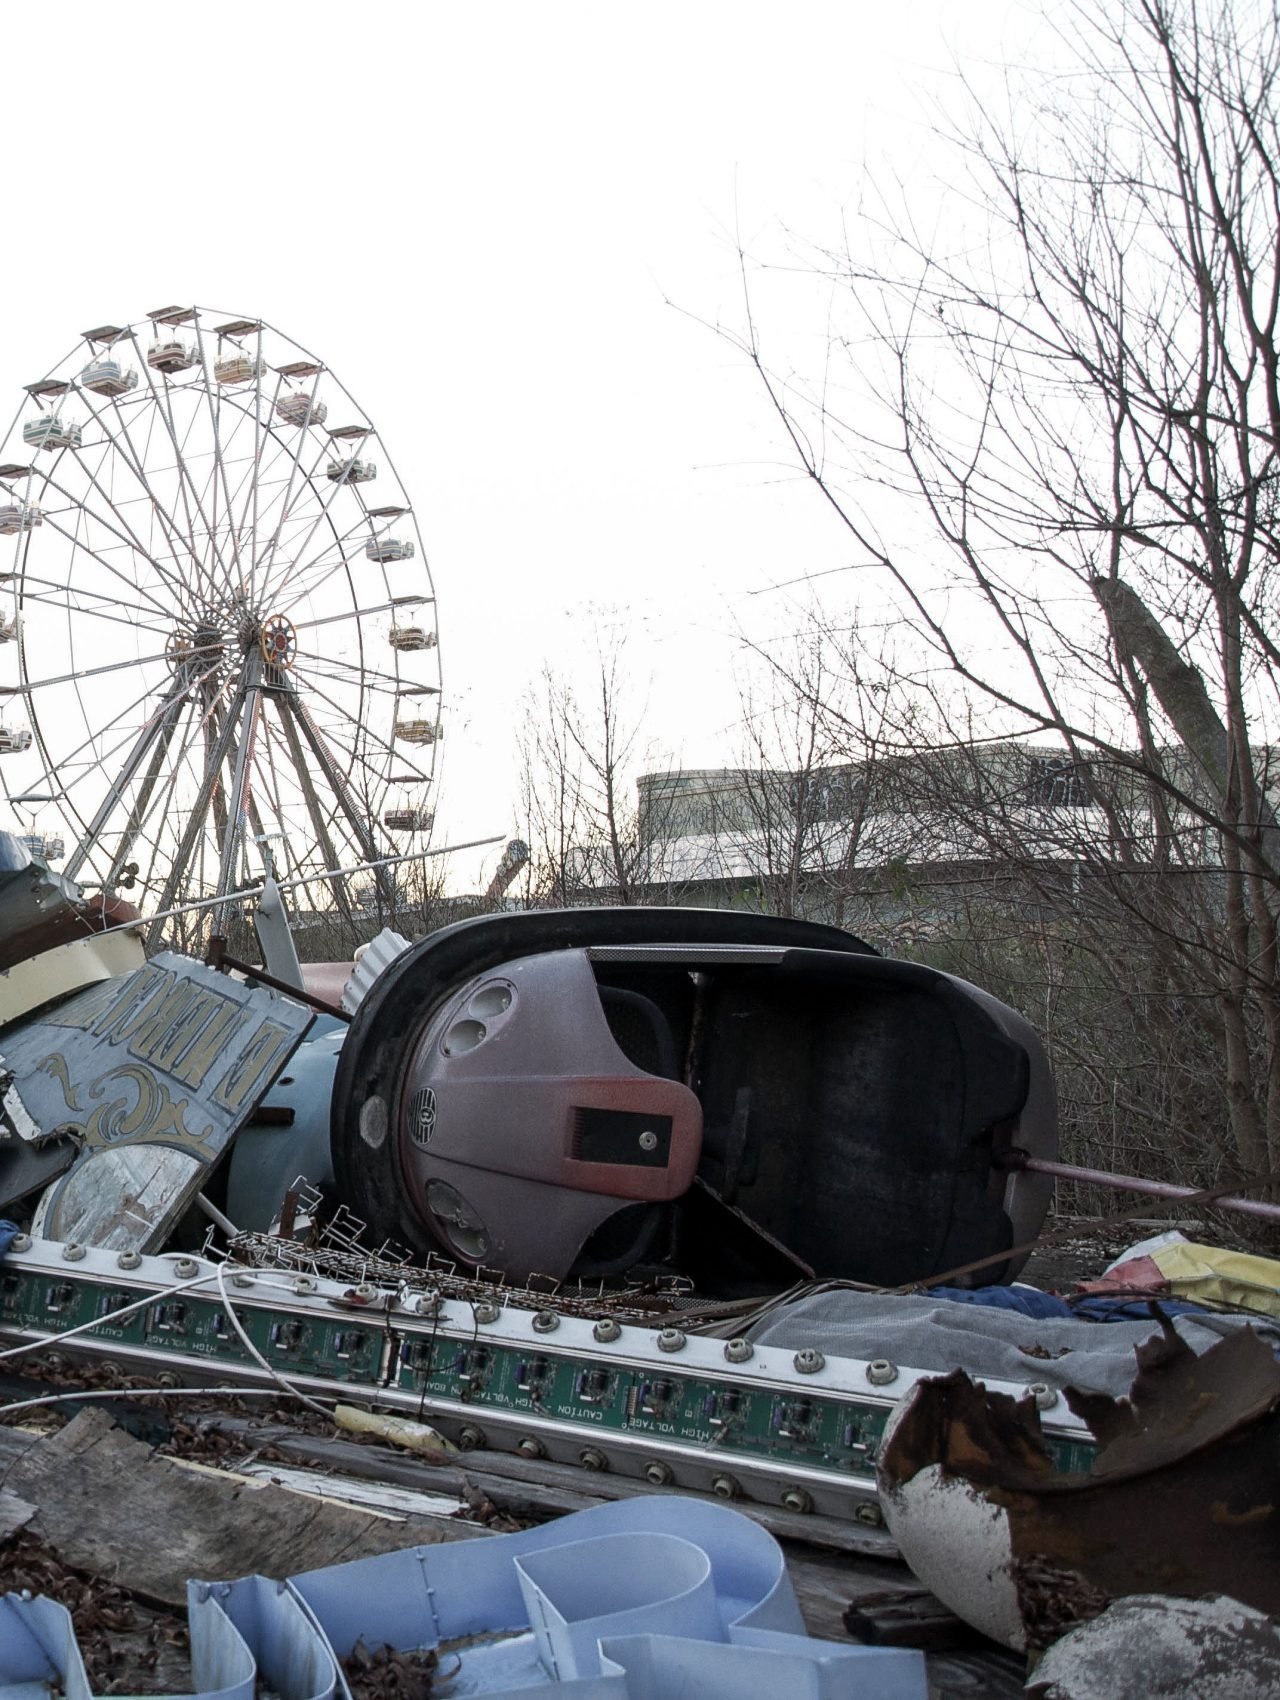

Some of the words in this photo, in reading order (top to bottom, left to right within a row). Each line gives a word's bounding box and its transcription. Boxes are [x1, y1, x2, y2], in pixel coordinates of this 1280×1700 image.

[86, 960, 257, 1093] MERCA
[43, 1317, 68, 1328] HIGH
[146, 1334, 187, 1348] VOLTAGE
[192, 1342, 217, 1353] HIGH
[473, 1389, 510, 1408] VOLTAG
[514, 1397, 536, 1410] IGH
[557, 1404, 603, 1421] CAUTION
[629, 1416, 676, 1434] VOLTAGE
[681, 1427, 710, 1441] HIGH
